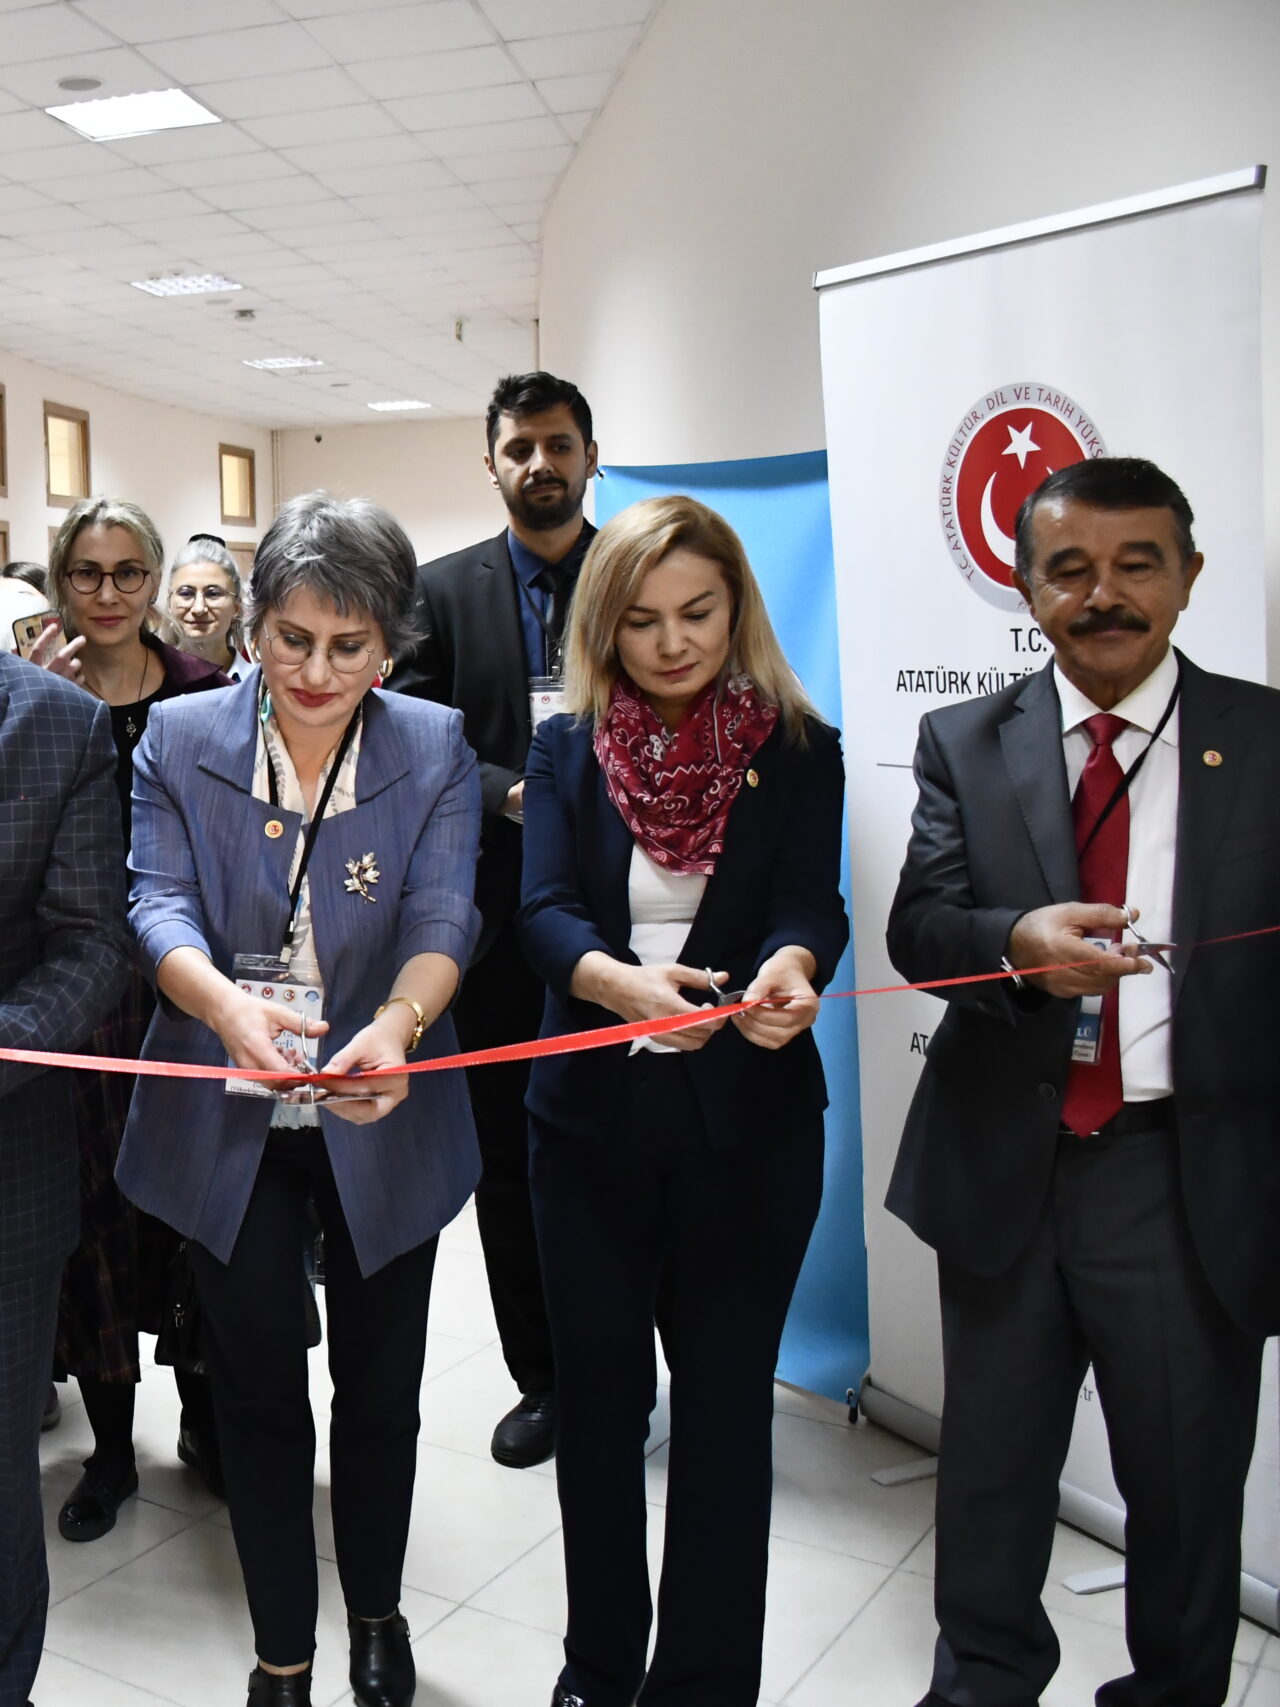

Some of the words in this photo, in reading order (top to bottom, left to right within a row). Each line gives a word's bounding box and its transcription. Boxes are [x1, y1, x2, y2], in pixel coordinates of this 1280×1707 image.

[940, 474, 961, 551] ATATÜRK
[986, 391, 1008, 411] DİL
[1013, 386, 1031, 401] VE
[1037, 387, 1075, 419] TARİH
[1010, 627, 1047, 652] T.C.
[896, 665, 972, 694] ATATÜRK
